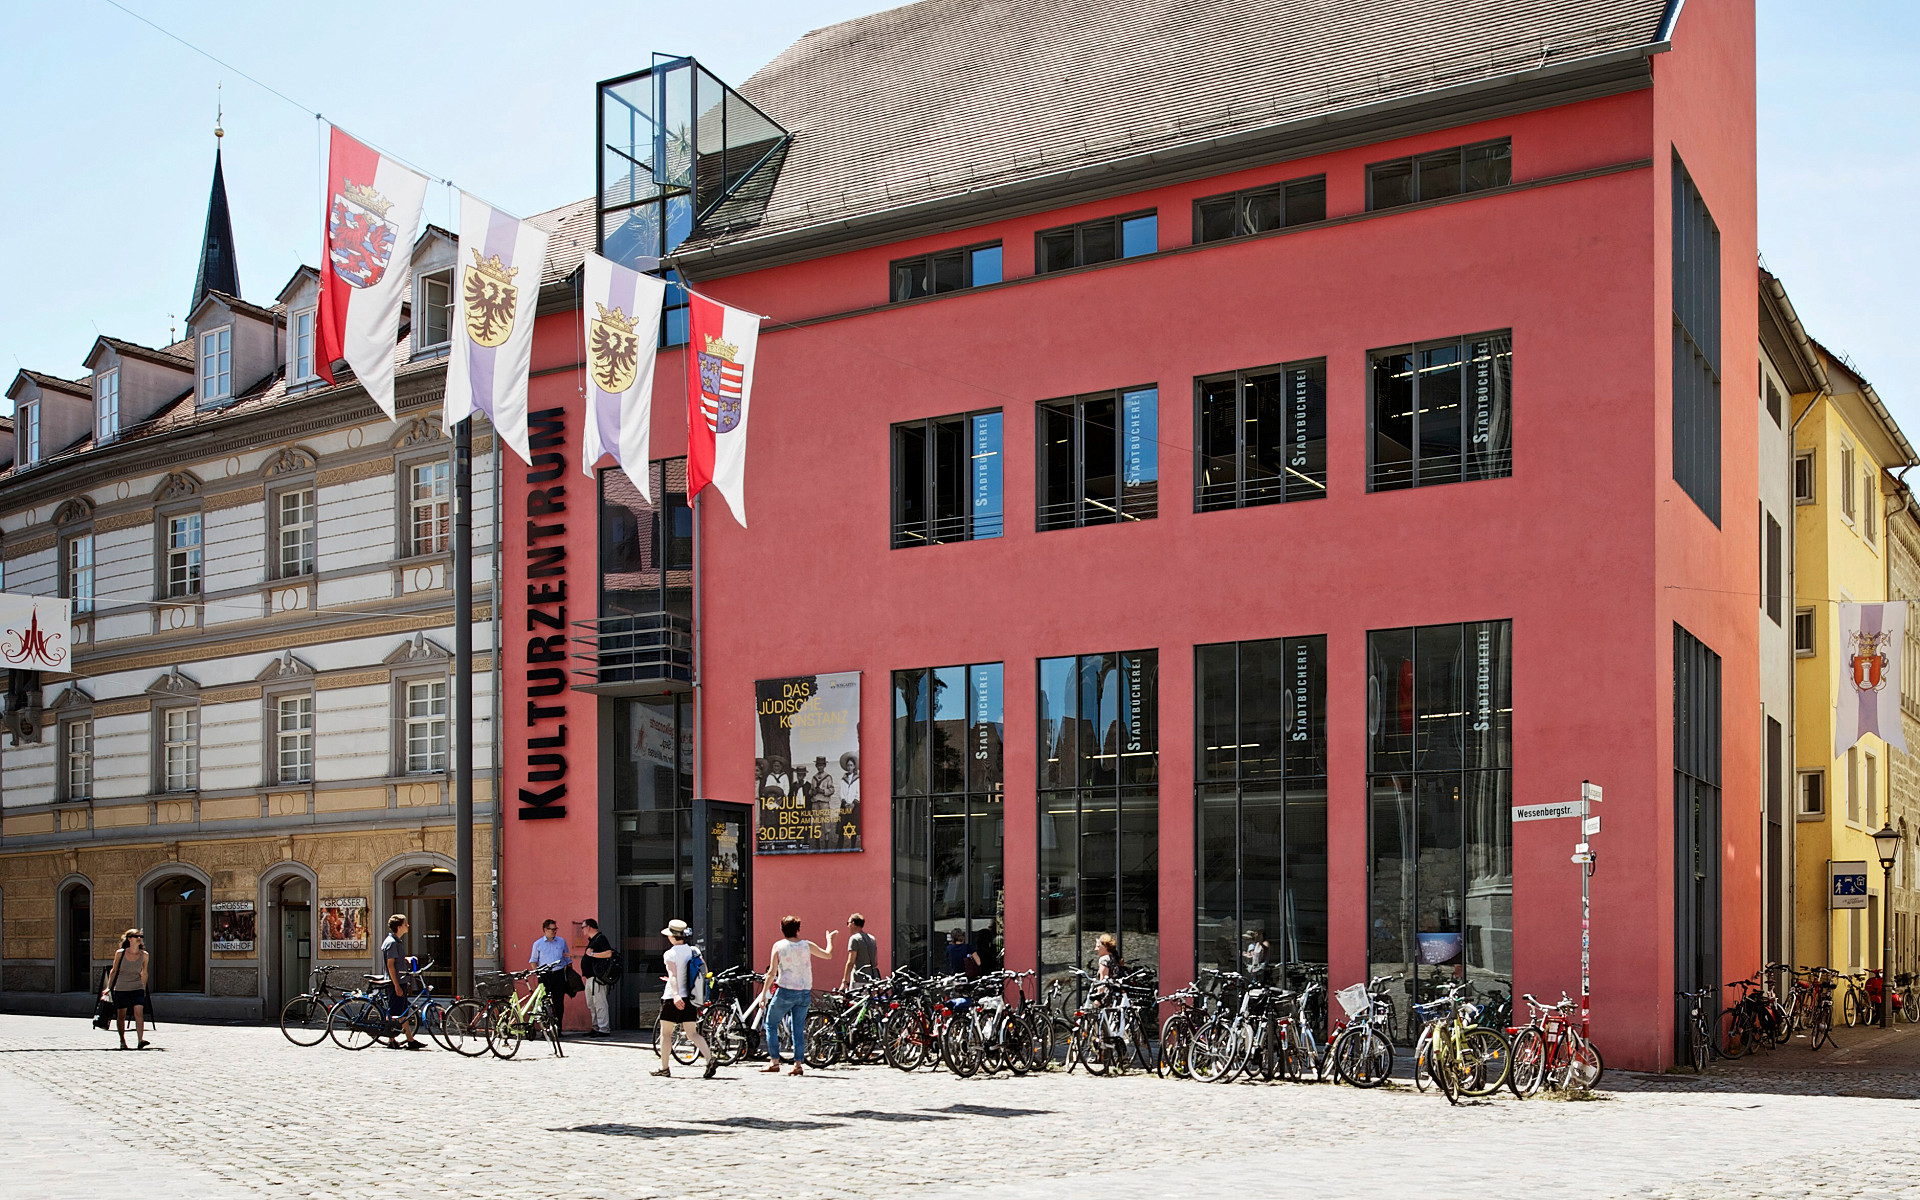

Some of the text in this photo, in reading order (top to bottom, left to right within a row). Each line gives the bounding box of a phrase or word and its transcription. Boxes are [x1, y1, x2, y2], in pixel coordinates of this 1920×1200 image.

[518, 406, 567, 820] KULTURZENTRUM
[783, 683, 810, 698] DAS
[758, 697, 822, 715] JÜDISCHE
[779, 710, 849, 729] KONSTANZ
[779, 811, 800, 825] BIS
[1517, 806, 1573, 818] Wessenbergstr.
[215, 901, 249, 910] GROSSER
[324, 898, 361, 907] GROSSER
[213, 941, 252, 950] INNENHOF
[322, 940, 365, 949] INNENHOF
